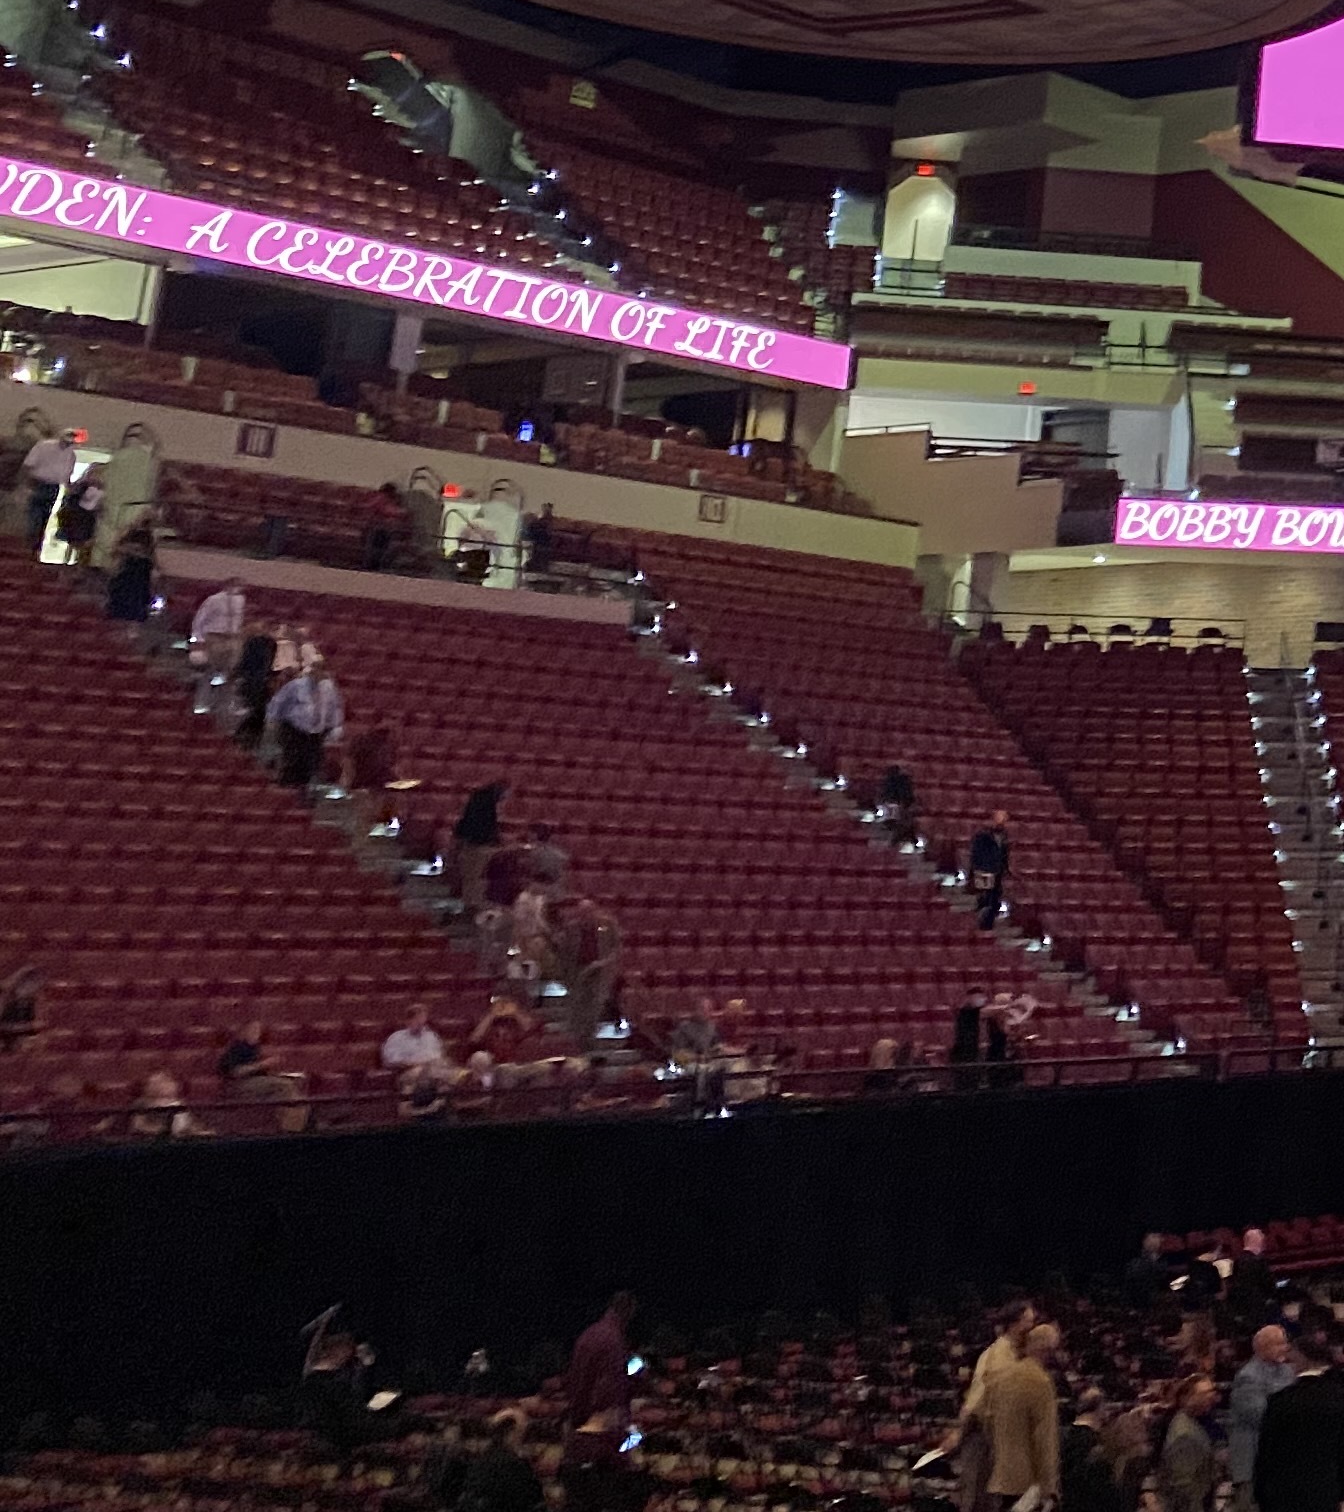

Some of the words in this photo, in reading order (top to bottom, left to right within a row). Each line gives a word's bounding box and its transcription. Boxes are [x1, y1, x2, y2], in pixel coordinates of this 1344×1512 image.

[0, 164, 153, 237] DEN:
[185, 210, 233, 253] A
[246, 221, 604, 333] CELEBRATION
[610, 301, 677, 346] OF
[673, 316, 777, 370] LIFE
[1119, 501, 1265, 548] BOBBY
